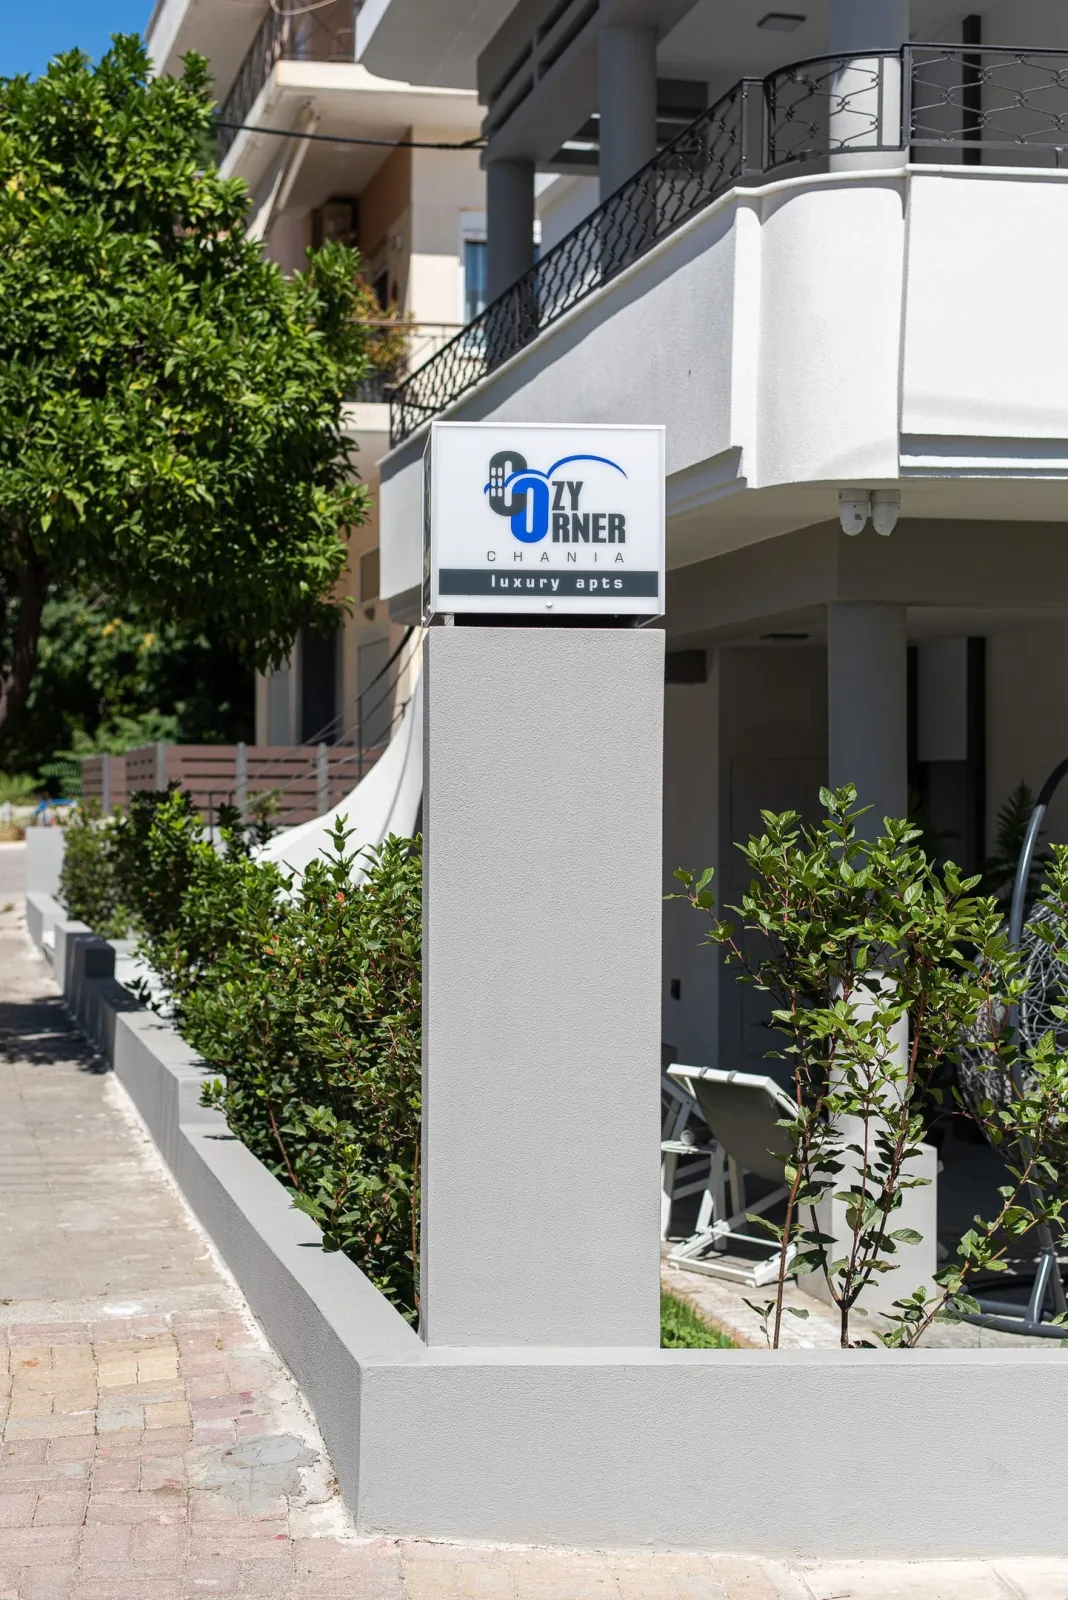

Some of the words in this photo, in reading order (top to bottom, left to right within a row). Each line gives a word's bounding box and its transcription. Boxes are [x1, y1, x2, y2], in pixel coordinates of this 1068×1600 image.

[487, 551, 624, 563] CHANIA
[491, 574, 560, 591] luxury
[575, 577, 624, 592] apts
